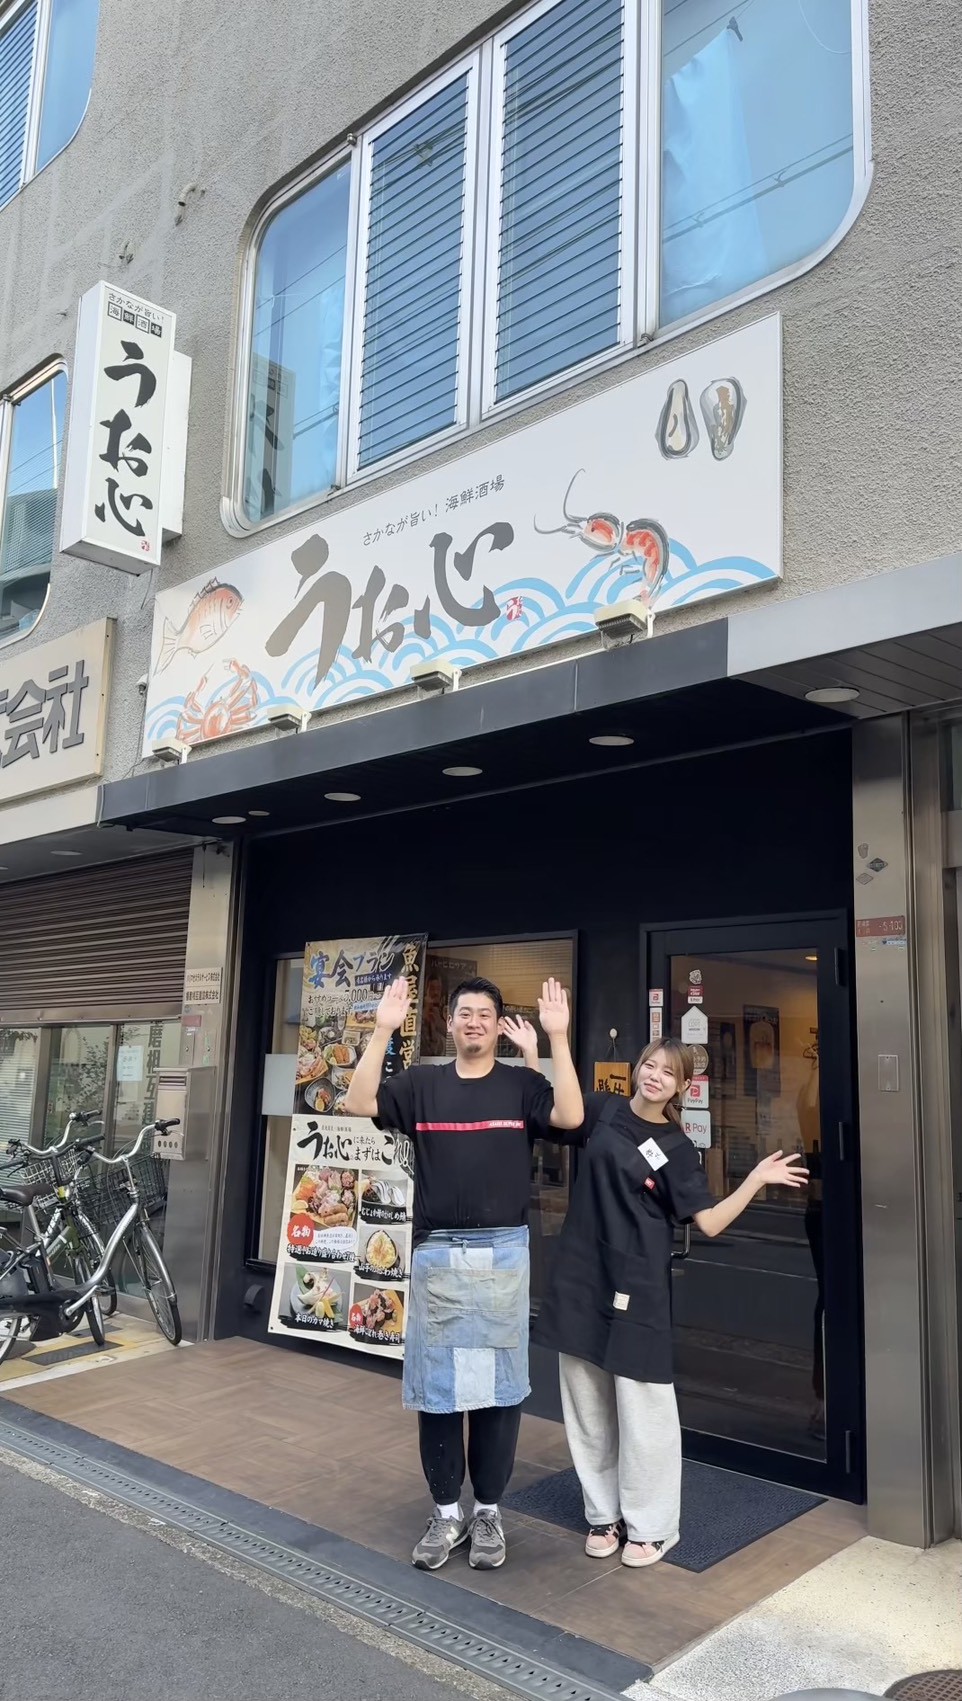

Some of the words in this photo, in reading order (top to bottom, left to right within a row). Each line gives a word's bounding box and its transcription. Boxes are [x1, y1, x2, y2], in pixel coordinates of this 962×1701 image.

[95, 340, 157, 537] うお心
[362, 503, 439, 547] さかなが旨い！
[445, 474, 506, 513] 海鮮酒場
[264, 521, 515, 691] うお心
[0, 659, 90, 769] 会社
[308, 949, 395, 989] 宴会プラン
[297, 1121, 353, 1161] うお心
[353, 1136, 376, 1145] に来たら
[685, 1123, 691, 1133] R
[693, 1123, 708, 1134] Pay
[354, 1146, 381, 1161] まずは
[291, 1225, 311, 1238] 名物
[295, 1313, 335, 1329] 本日のカマ焼き
